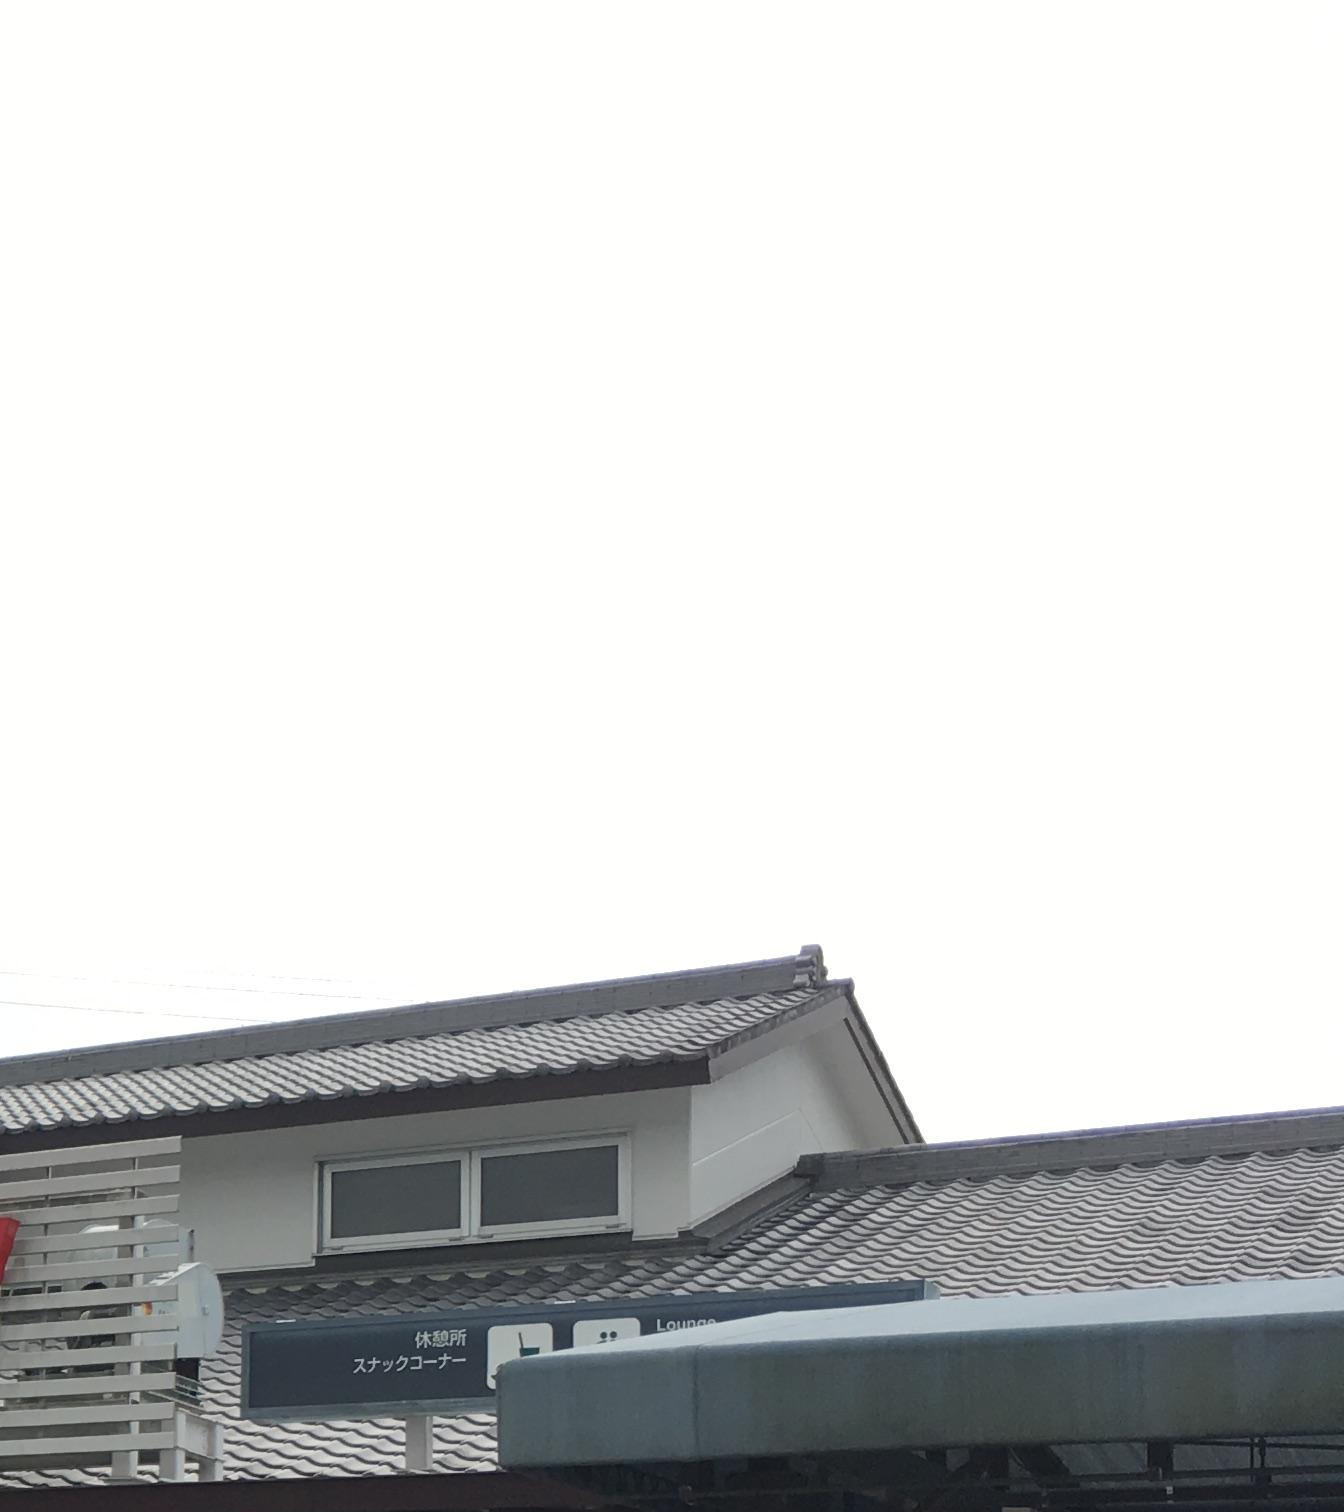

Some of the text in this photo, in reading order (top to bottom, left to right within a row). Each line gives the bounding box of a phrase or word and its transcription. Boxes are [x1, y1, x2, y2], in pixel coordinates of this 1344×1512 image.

[415, 1328, 467, 1349] 休憩所
[353, 1353, 467, 1374] スナックコーナー
